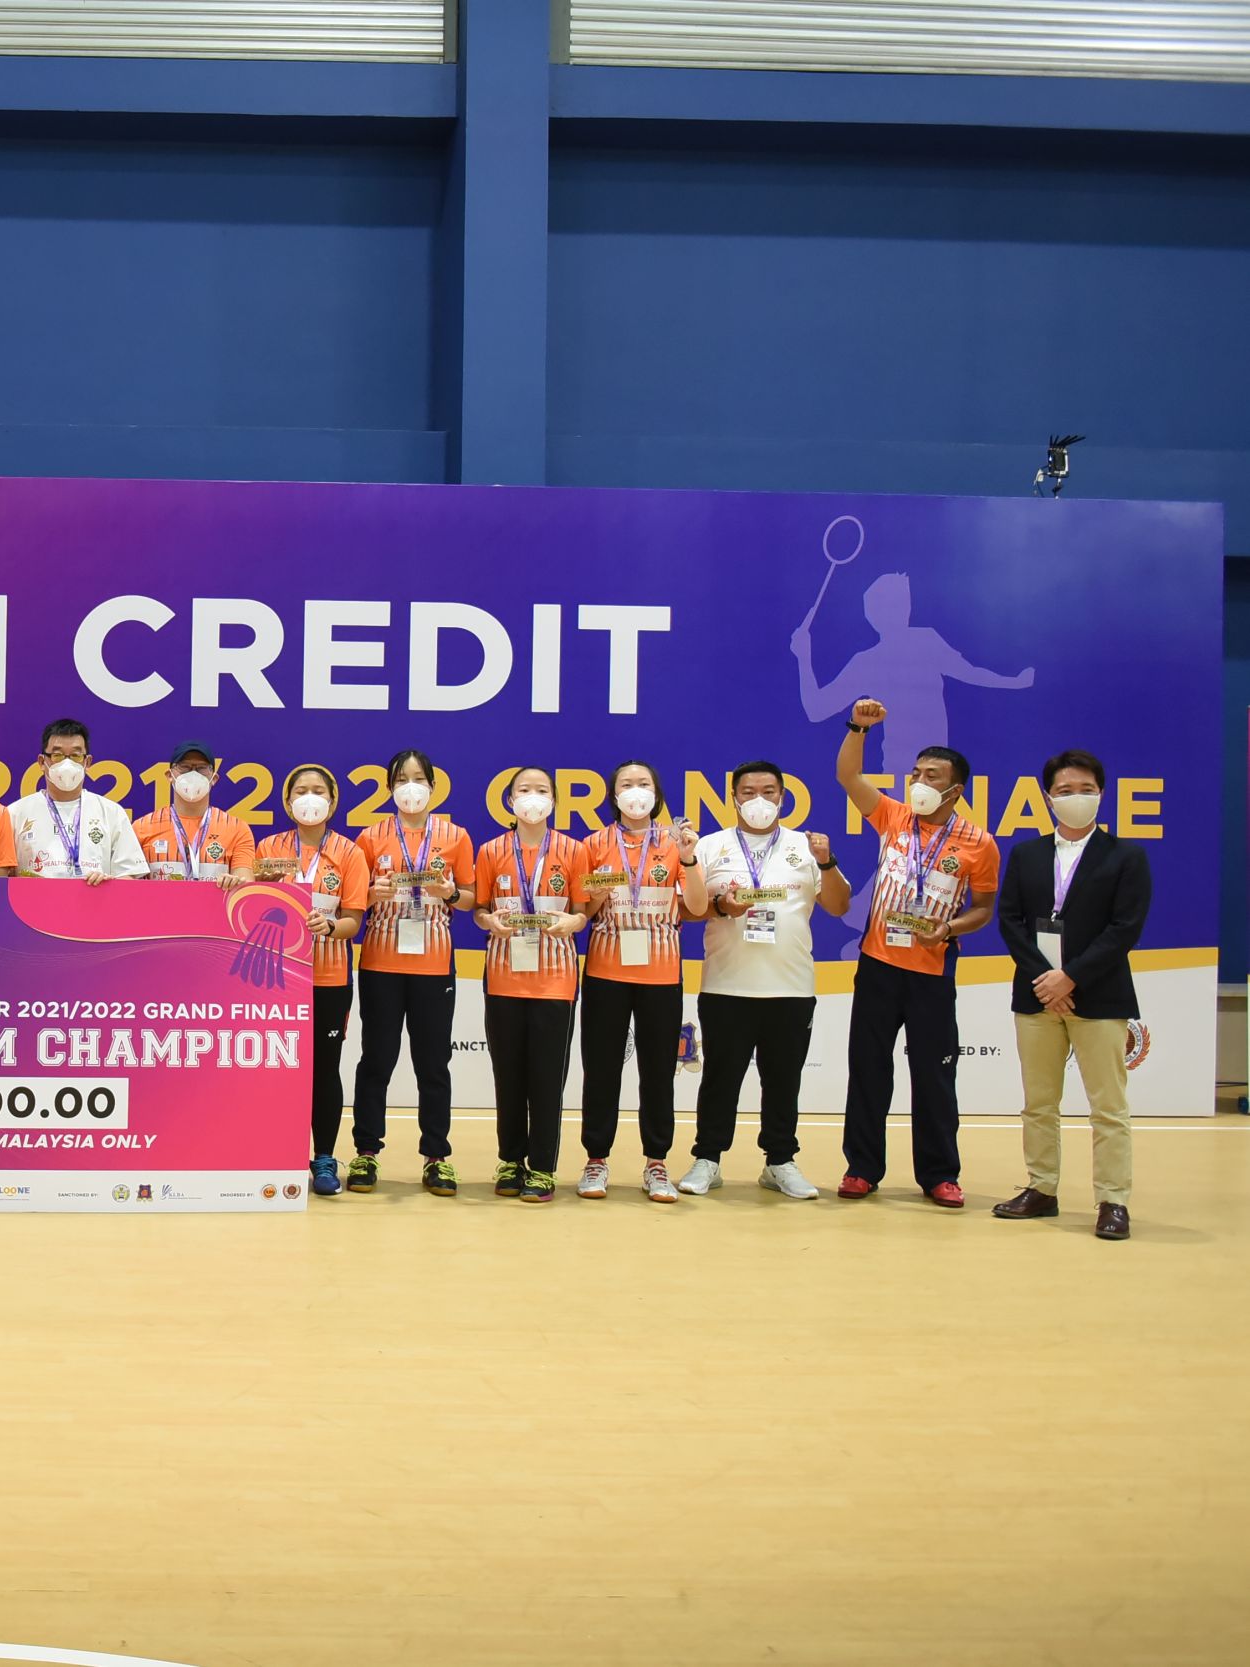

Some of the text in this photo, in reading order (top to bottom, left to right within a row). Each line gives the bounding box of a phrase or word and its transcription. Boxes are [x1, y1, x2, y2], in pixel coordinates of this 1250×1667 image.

[73, 595, 671, 714] CREDIT
[585, 877, 625, 885] CHAMPION
[17, 1001, 136, 1020] 2021/2022
[143, 1002, 224, 1020] GRAND
[231, 1003, 310, 1021] FINALE
[36, 1028, 299, 1069] CHAMPION
[980, 1046, 1001, 1058] BY:
[101, 1134, 157, 1149] ONLY
